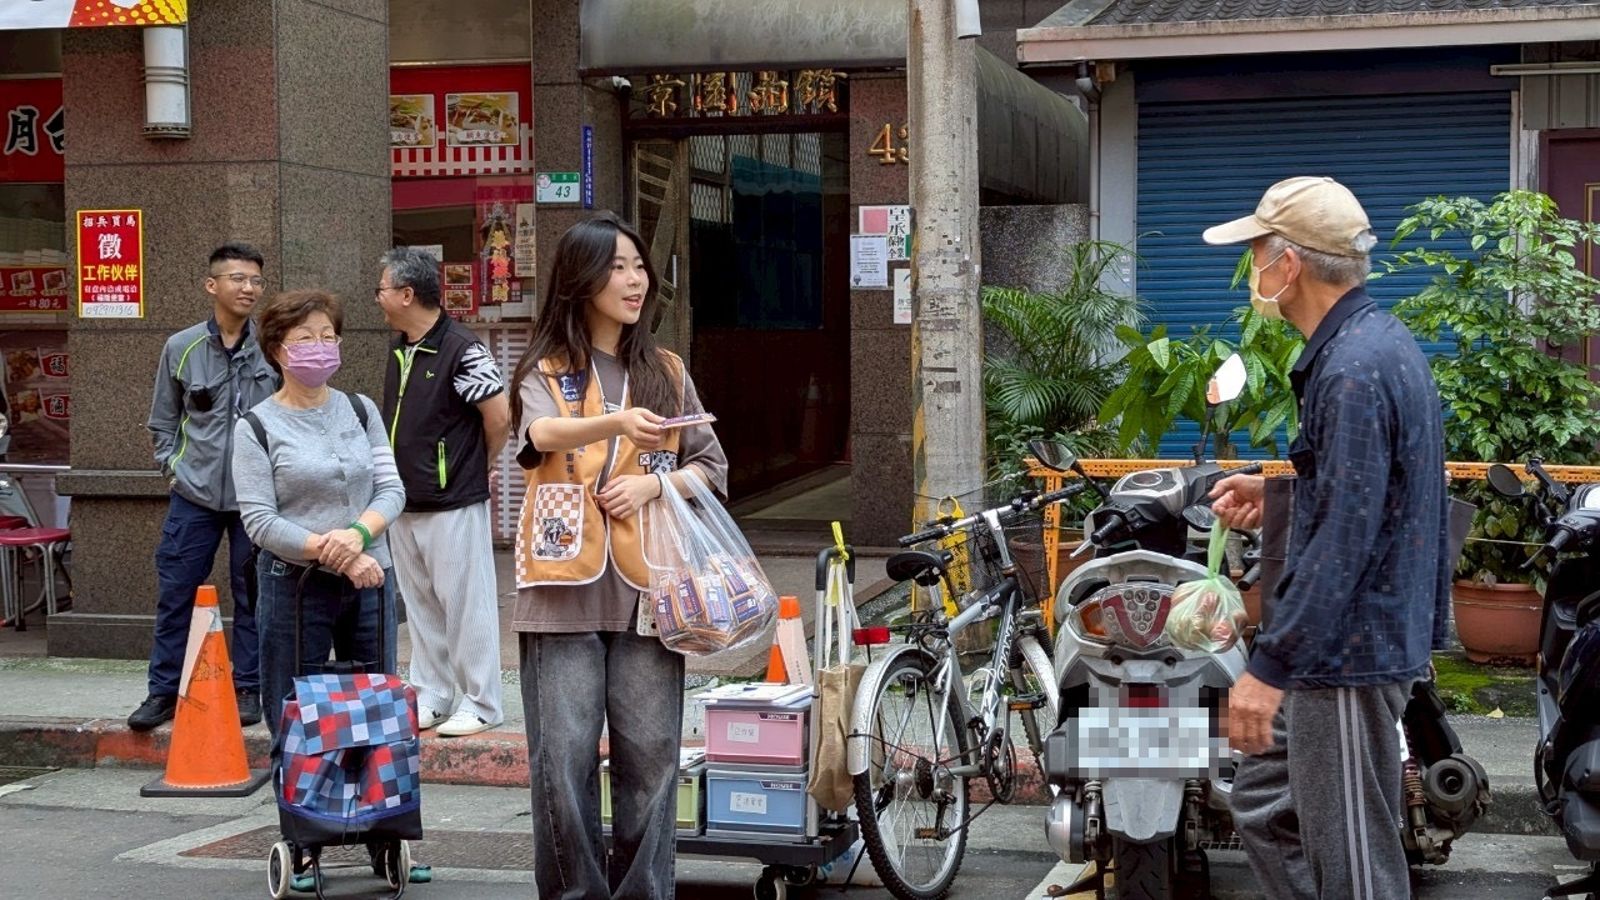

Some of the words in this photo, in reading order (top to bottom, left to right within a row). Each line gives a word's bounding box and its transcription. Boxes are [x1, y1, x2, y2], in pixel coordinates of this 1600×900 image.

[555, 185, 571, 199] 43
[83, 214, 136, 229] 招兵買馬
[98, 233, 122, 260] 徵
[83, 264, 138, 281] 工作伙伴
